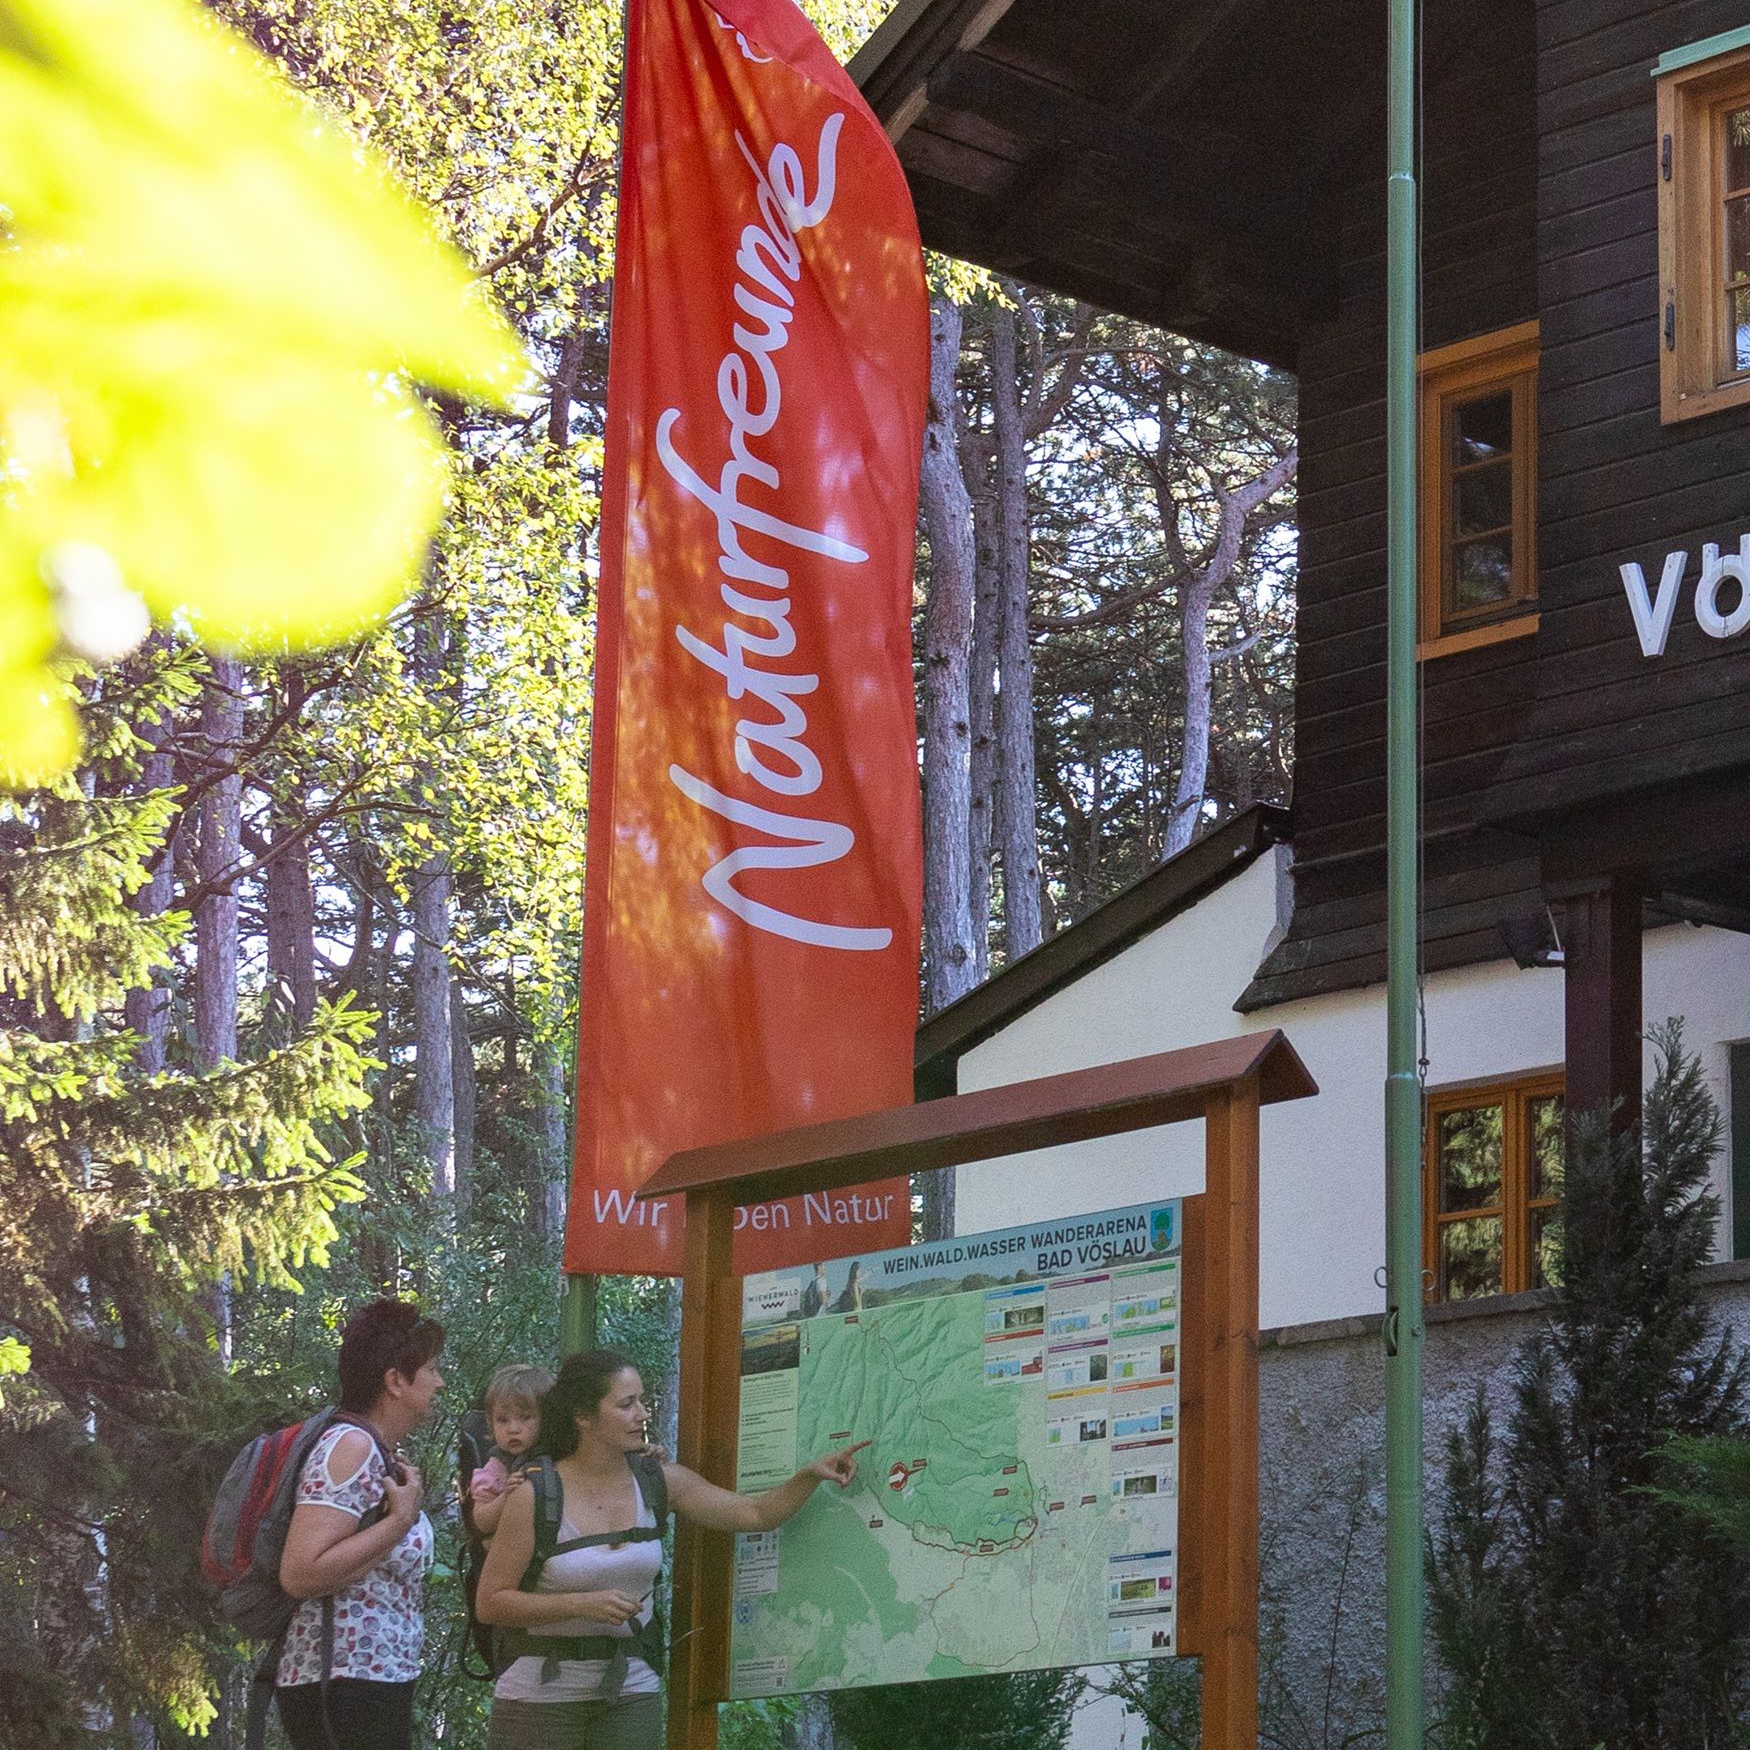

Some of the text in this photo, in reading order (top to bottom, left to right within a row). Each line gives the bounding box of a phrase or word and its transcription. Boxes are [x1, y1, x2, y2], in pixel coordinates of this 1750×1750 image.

[656, 112, 893, 951] Naturfreunde
[593, 1189, 668, 1227] Wir
[804, 1190, 893, 1227] Natur
[1030, 1214, 1147, 1250] WANDERARENA
[1037, 1235, 1147, 1272] BAD VÖSLAU
